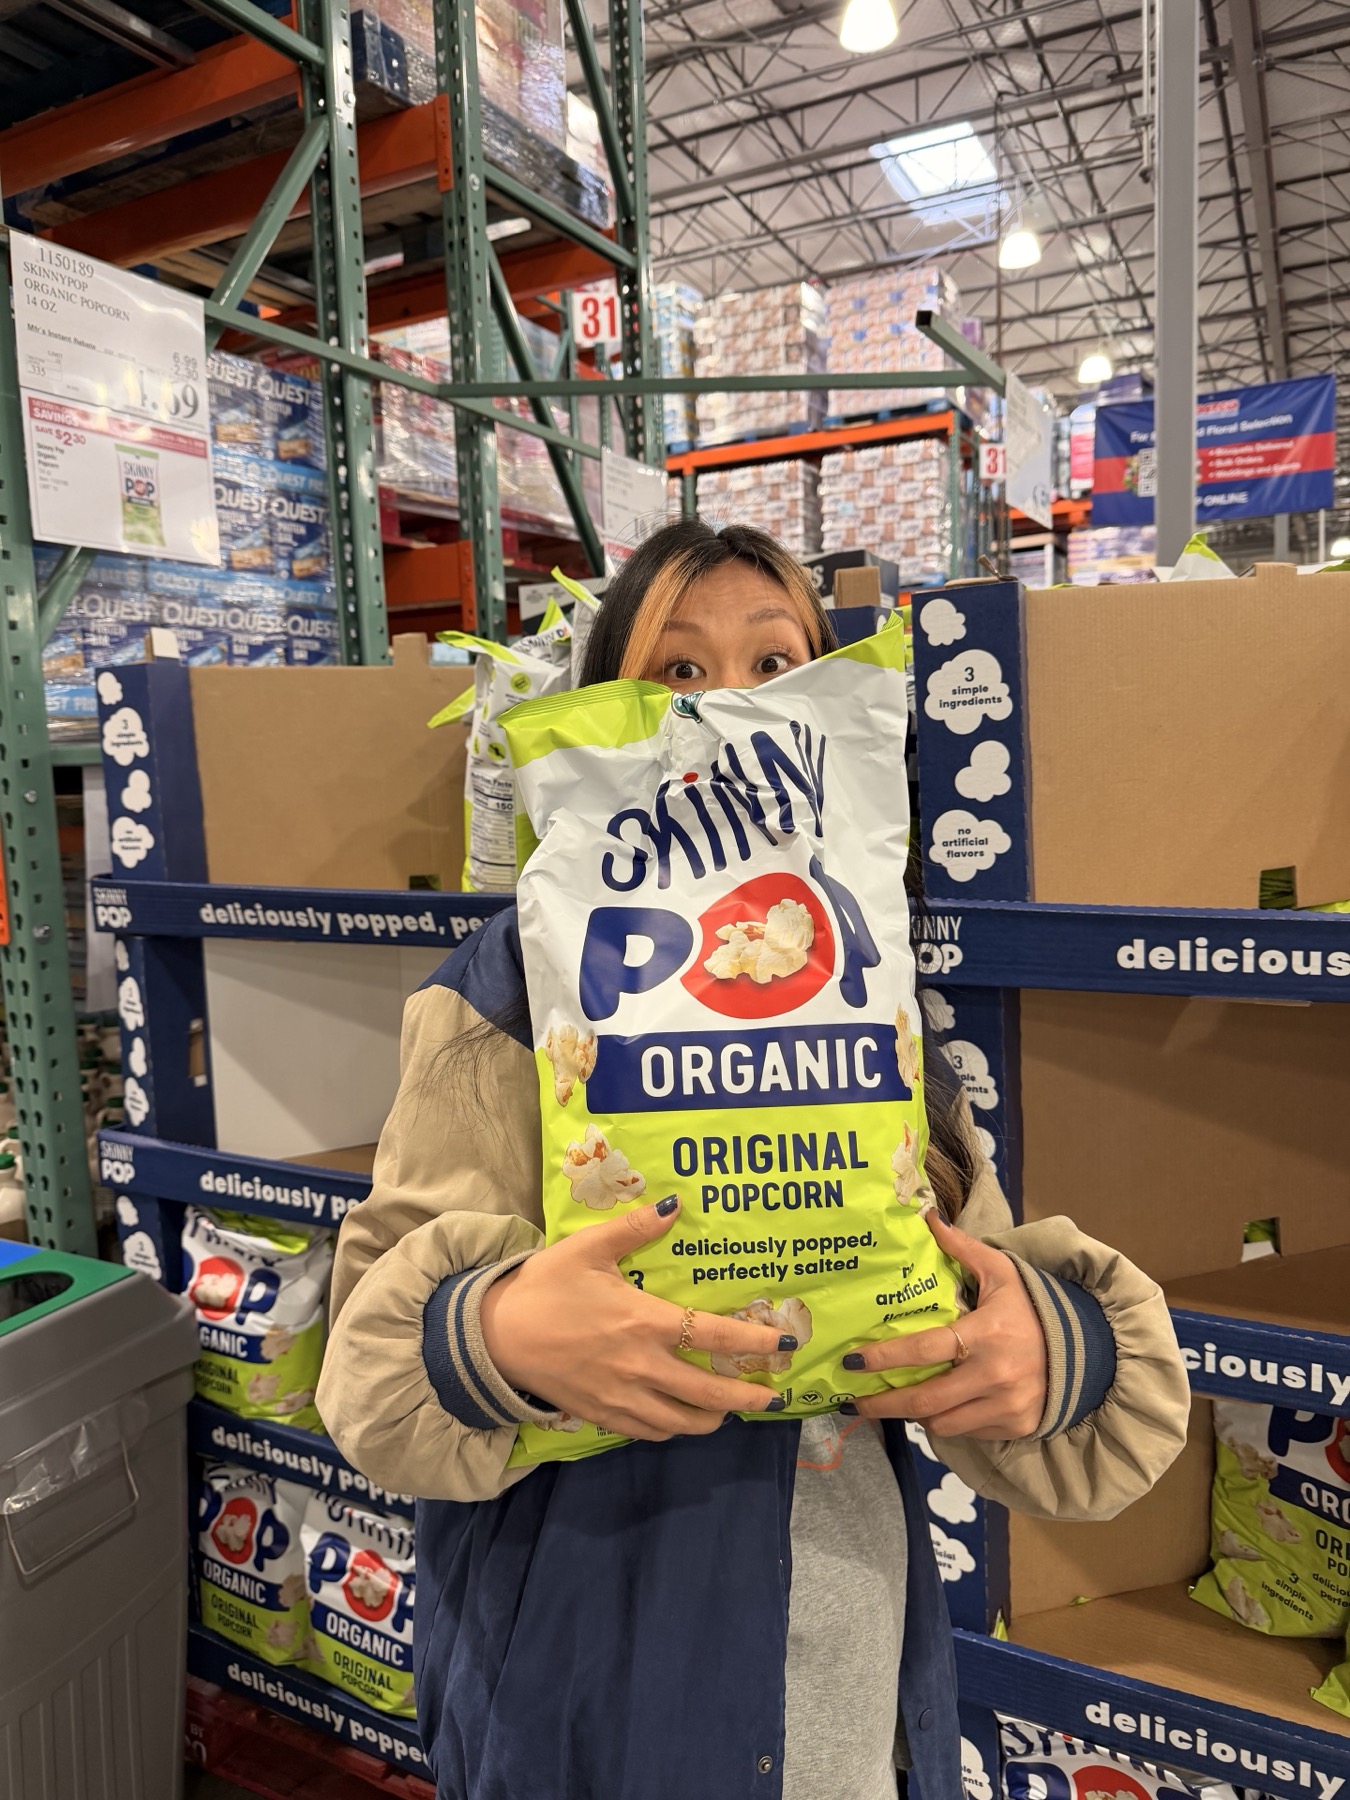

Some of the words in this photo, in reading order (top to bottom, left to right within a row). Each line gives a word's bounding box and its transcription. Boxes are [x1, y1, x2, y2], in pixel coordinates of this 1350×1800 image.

[23, 262, 89, 292] SKINNYPOP
[38, 248, 95, 278] 1150189
[24, 277, 78, 304] ORGANIC
[80, 296, 130, 322] POPCORN
[26, 294, 38, 306] 14
[40, 299, 58, 314] OZ
[582, 297, 617, 338] 31
[256, 373, 311, 406] QUEST
[1240, 414, 1293, 432] Selection
[125, 477, 156, 497] POP
[215, 484, 268, 515] QUEST
[270, 496, 330, 525] QUEST
[81, 594, 153, 623] QUEST
[162, 605, 226, 628] QUEST
[287, 614, 339, 637] QUEST
[951, 684, 989, 696] simple
[964, 667, 975, 682] 3
[938, 695, 1003, 709] ingredients
[495, 801, 514, 811] 150
[601, 720, 827, 893] SKINNY
[941, 836, 989, 847] artificial
[957, 826, 971, 835] no
[945, 848, 985, 859] flavors
[96, 904, 133, 929] POP
[199, 902, 332, 936] deliciously
[337, 911, 446, 938] popped,
[578, 854, 882, 1022] POP
[1116, 936, 1350, 977] delicious
[640, 1036, 882, 1098] ORGANIC
[100, 1140, 134, 1163] SKINNY
[672, 1130, 869, 1178] ORIGINAL
[102, 1159, 136, 1184] POP
[200, 1170, 327, 1218] deliciously
[701, 1179, 844, 1214] POPCORN
[671, 1236, 788, 1259] deliciously
[792, 1231, 878, 1257] popped,
[692, 1261, 789, 1285] perfectly
[793, 1255, 859, 1276] salted
[875, 1272, 939, 1306] artificial
[211, 1425, 334, 1487] deliciously
[202, 1558, 267, 1605] ORGANIC
[1275, 1578, 1307, 1604] simple
[1288, 1572, 1300, 1584] 3
[210, 1594, 259, 1629] ORIGINAL
[1261, 1581, 1315, 1622] ingredients
[217, 1615, 253, 1639] POPCORN
[325, 1611, 405, 1667] ORGANIC
[332, 1650, 395, 1692] ORIGINAL
[340, 1671, 384, 1701] POPCORN
[227, 1661, 345, 1734] deliciously
[1085, 1701, 1346, 1800] deliciously
